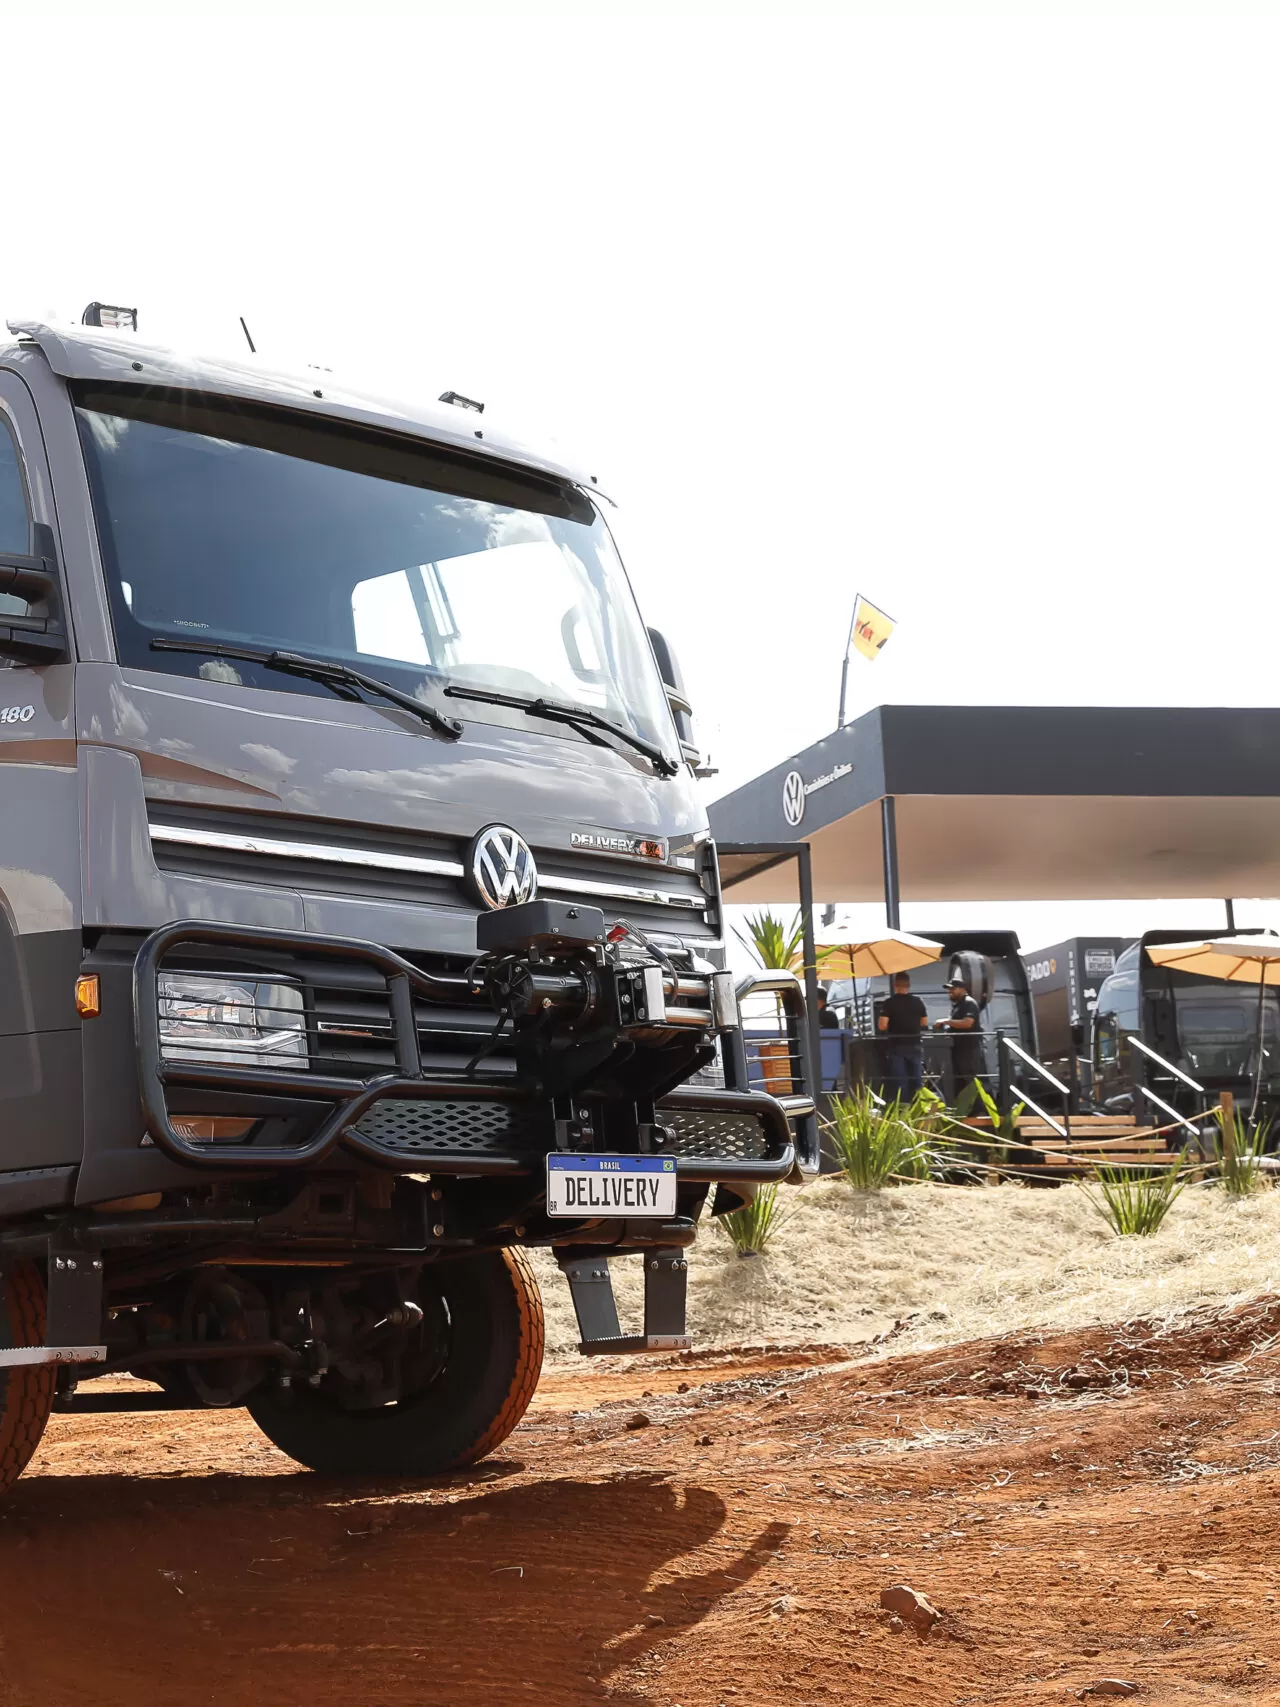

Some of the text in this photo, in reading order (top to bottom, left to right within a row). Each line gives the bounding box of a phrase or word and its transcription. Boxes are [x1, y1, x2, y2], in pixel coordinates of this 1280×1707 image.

[570, 832, 636, 853] DELIVERY
[600, 1161, 621, 1170] BRASIL
[565, 1177, 660, 1207] DELIVERY
